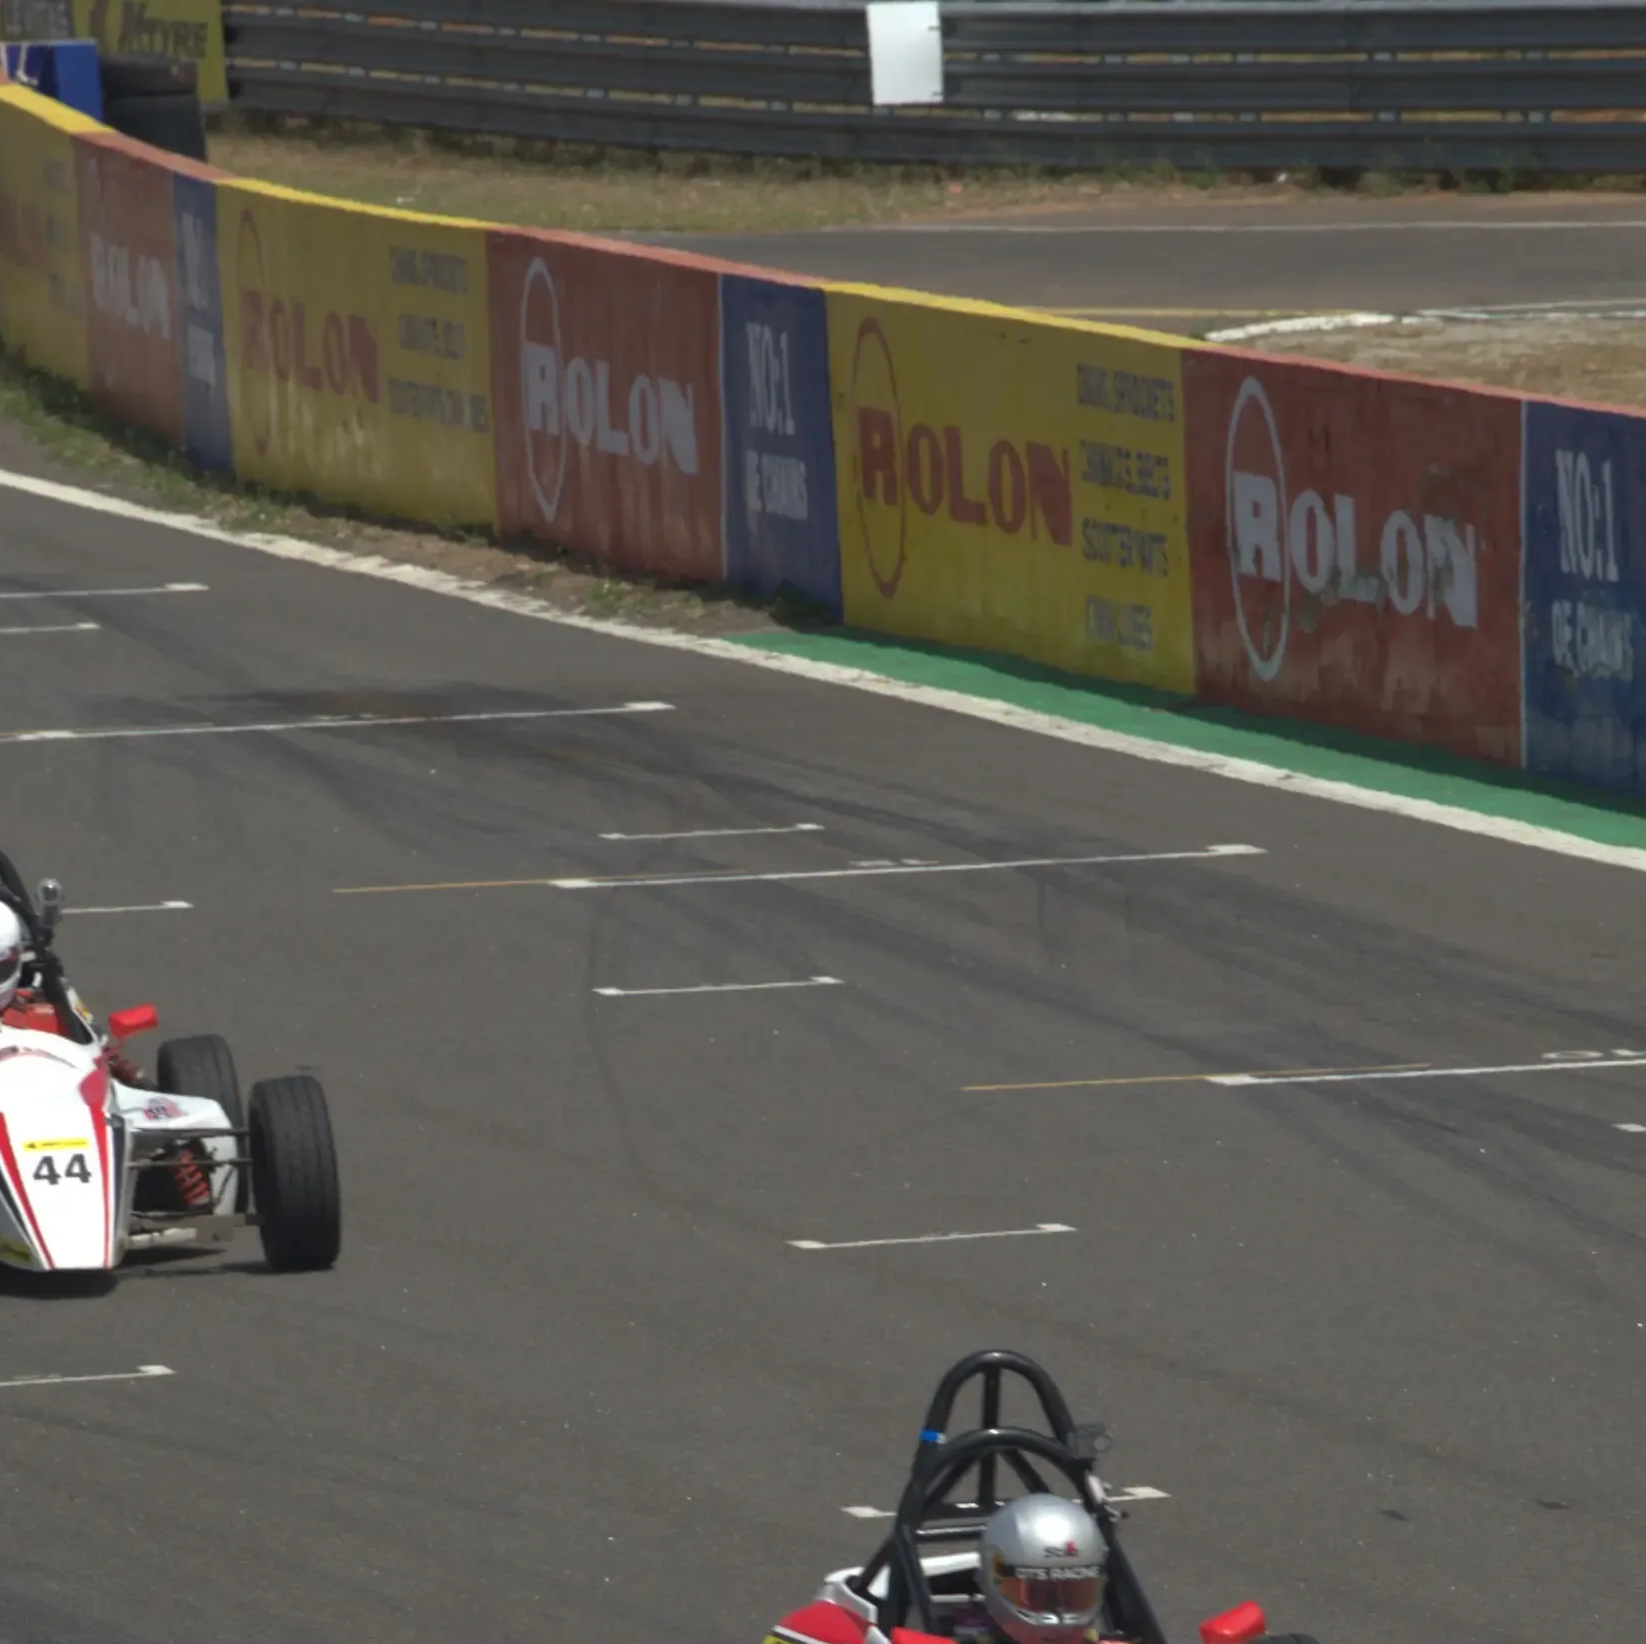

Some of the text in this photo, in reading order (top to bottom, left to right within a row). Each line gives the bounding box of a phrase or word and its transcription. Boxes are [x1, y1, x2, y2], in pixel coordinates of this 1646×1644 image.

[523, 340, 699, 475] ROLON
[858, 406, 1073, 547] ROLON
[1234, 470, 1478, 629] ROLON
[32, 1153, 93, 1186] 44
